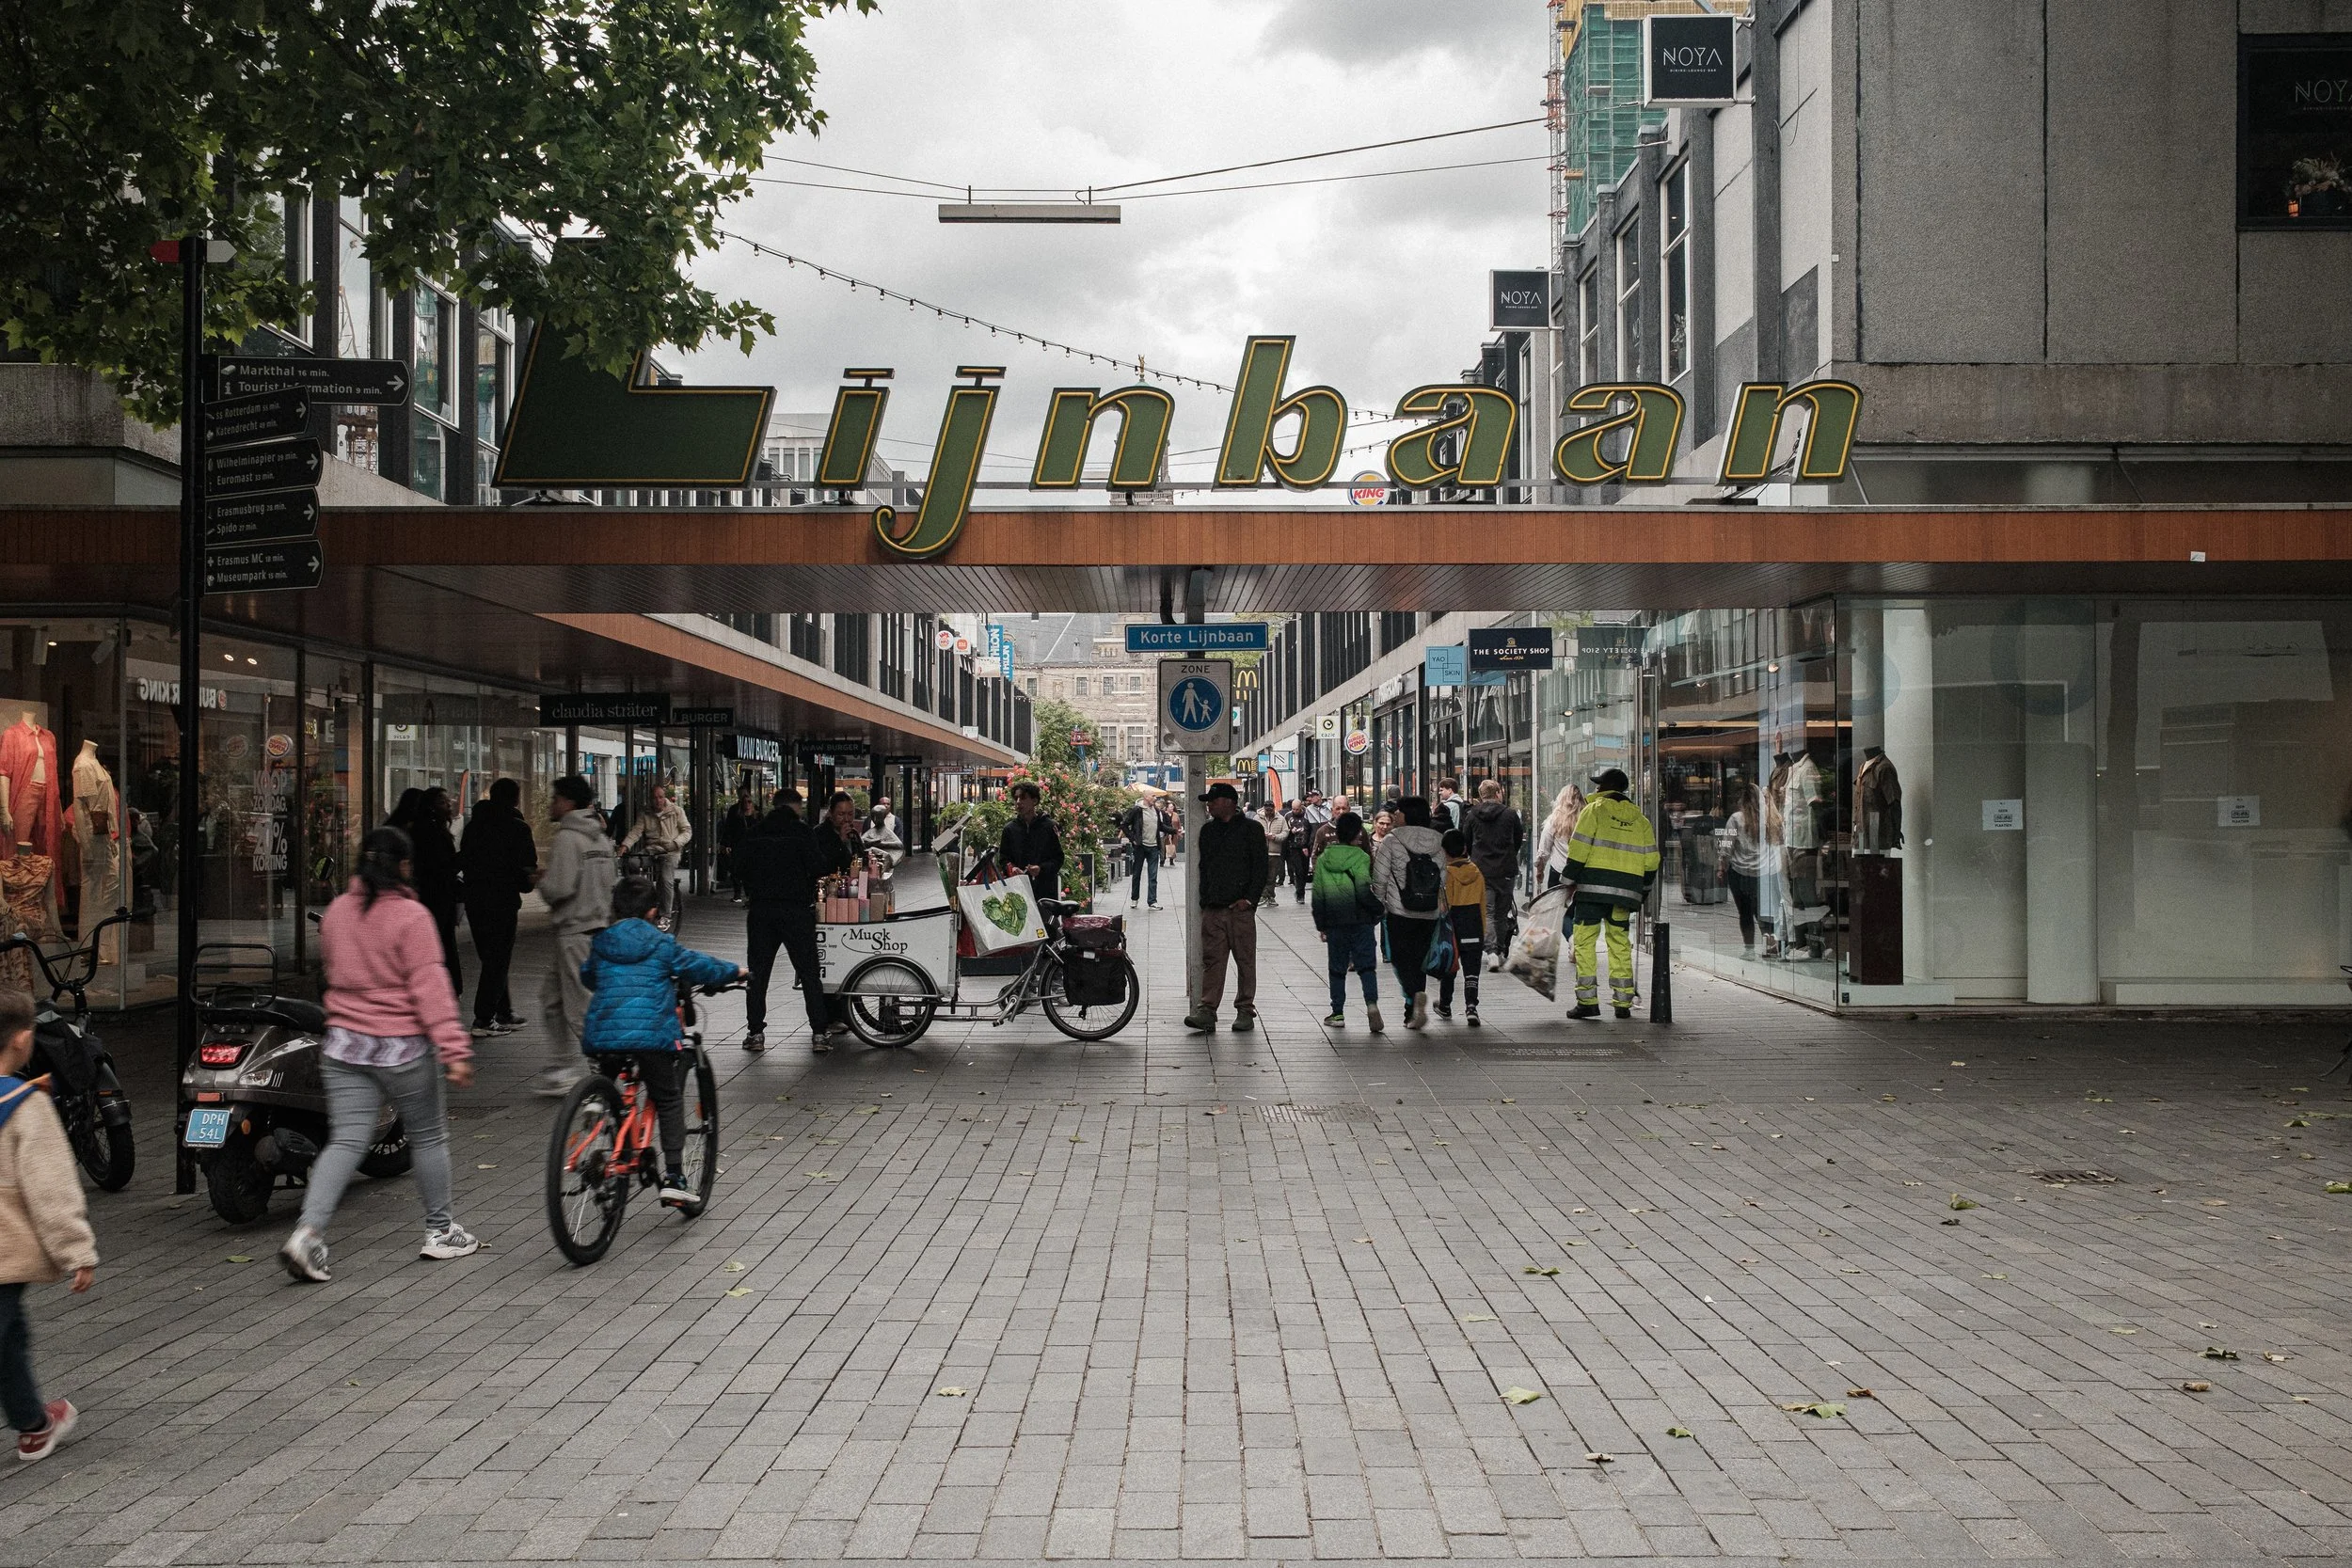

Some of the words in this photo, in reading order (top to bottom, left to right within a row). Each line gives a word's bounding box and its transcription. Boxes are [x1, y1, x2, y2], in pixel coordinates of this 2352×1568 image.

[1663, 47, 1723, 66] NOYA
[2296, 79, 2352, 103] NOY
[1502, 291, 1542, 305] NOYA
[240, 365, 294, 376] Markthal
[310, 368, 330, 377] min.
[238, 381, 278, 393] Tourist
[283, 382, 353, 394] rmation
[363, 386, 383, 395] min.
[492, 239, 1863, 561] Lijnbaan
[225, 404, 262, 419] Rotterdam
[216, 420, 258, 437] Katendrecht
[216, 453, 276, 469] Wilhelminapier
[285, 451, 298, 460] min.
[217, 472, 253, 485] Euromast
[262, 471, 275, 481] min.
[1354, 488, 1385, 499] KING
[217, 503, 264, 517] Erasmusbrug
[274, 502, 287, 511] min.
[216, 523, 237, 536] Spido
[217, 556, 249, 566] Erasmus
[251, 553, 263, 563] MC
[272, 553, 285, 562] min.
[216, 570, 266, 583] Museumpark
[275, 571, 288, 579] min.
[1140, 631, 1182, 644] Korte
[1188, 630, 1254, 647] Lijnbaan
[1493, 647, 1528, 656] SOCIETY
[1181, 665, 1211, 673] ZONE
[552, 703, 603, 719] claudia
[608, 703, 658, 719] sträter
[681, 713, 728, 722] BURGER
[1348, 734, 1365, 743] BURGER
[1349, 738, 1366, 750] KING
[737, 735, 755, 760] WAW
[755, 737, 780, 763] BURGER
[253, 769, 287, 795] KOOP
[253, 855, 287, 871] KORTING
[871, 932, 908, 954] Shop
[201, 1113, 225, 1125] DPH
[199, 1127, 219, 1139] 54L
